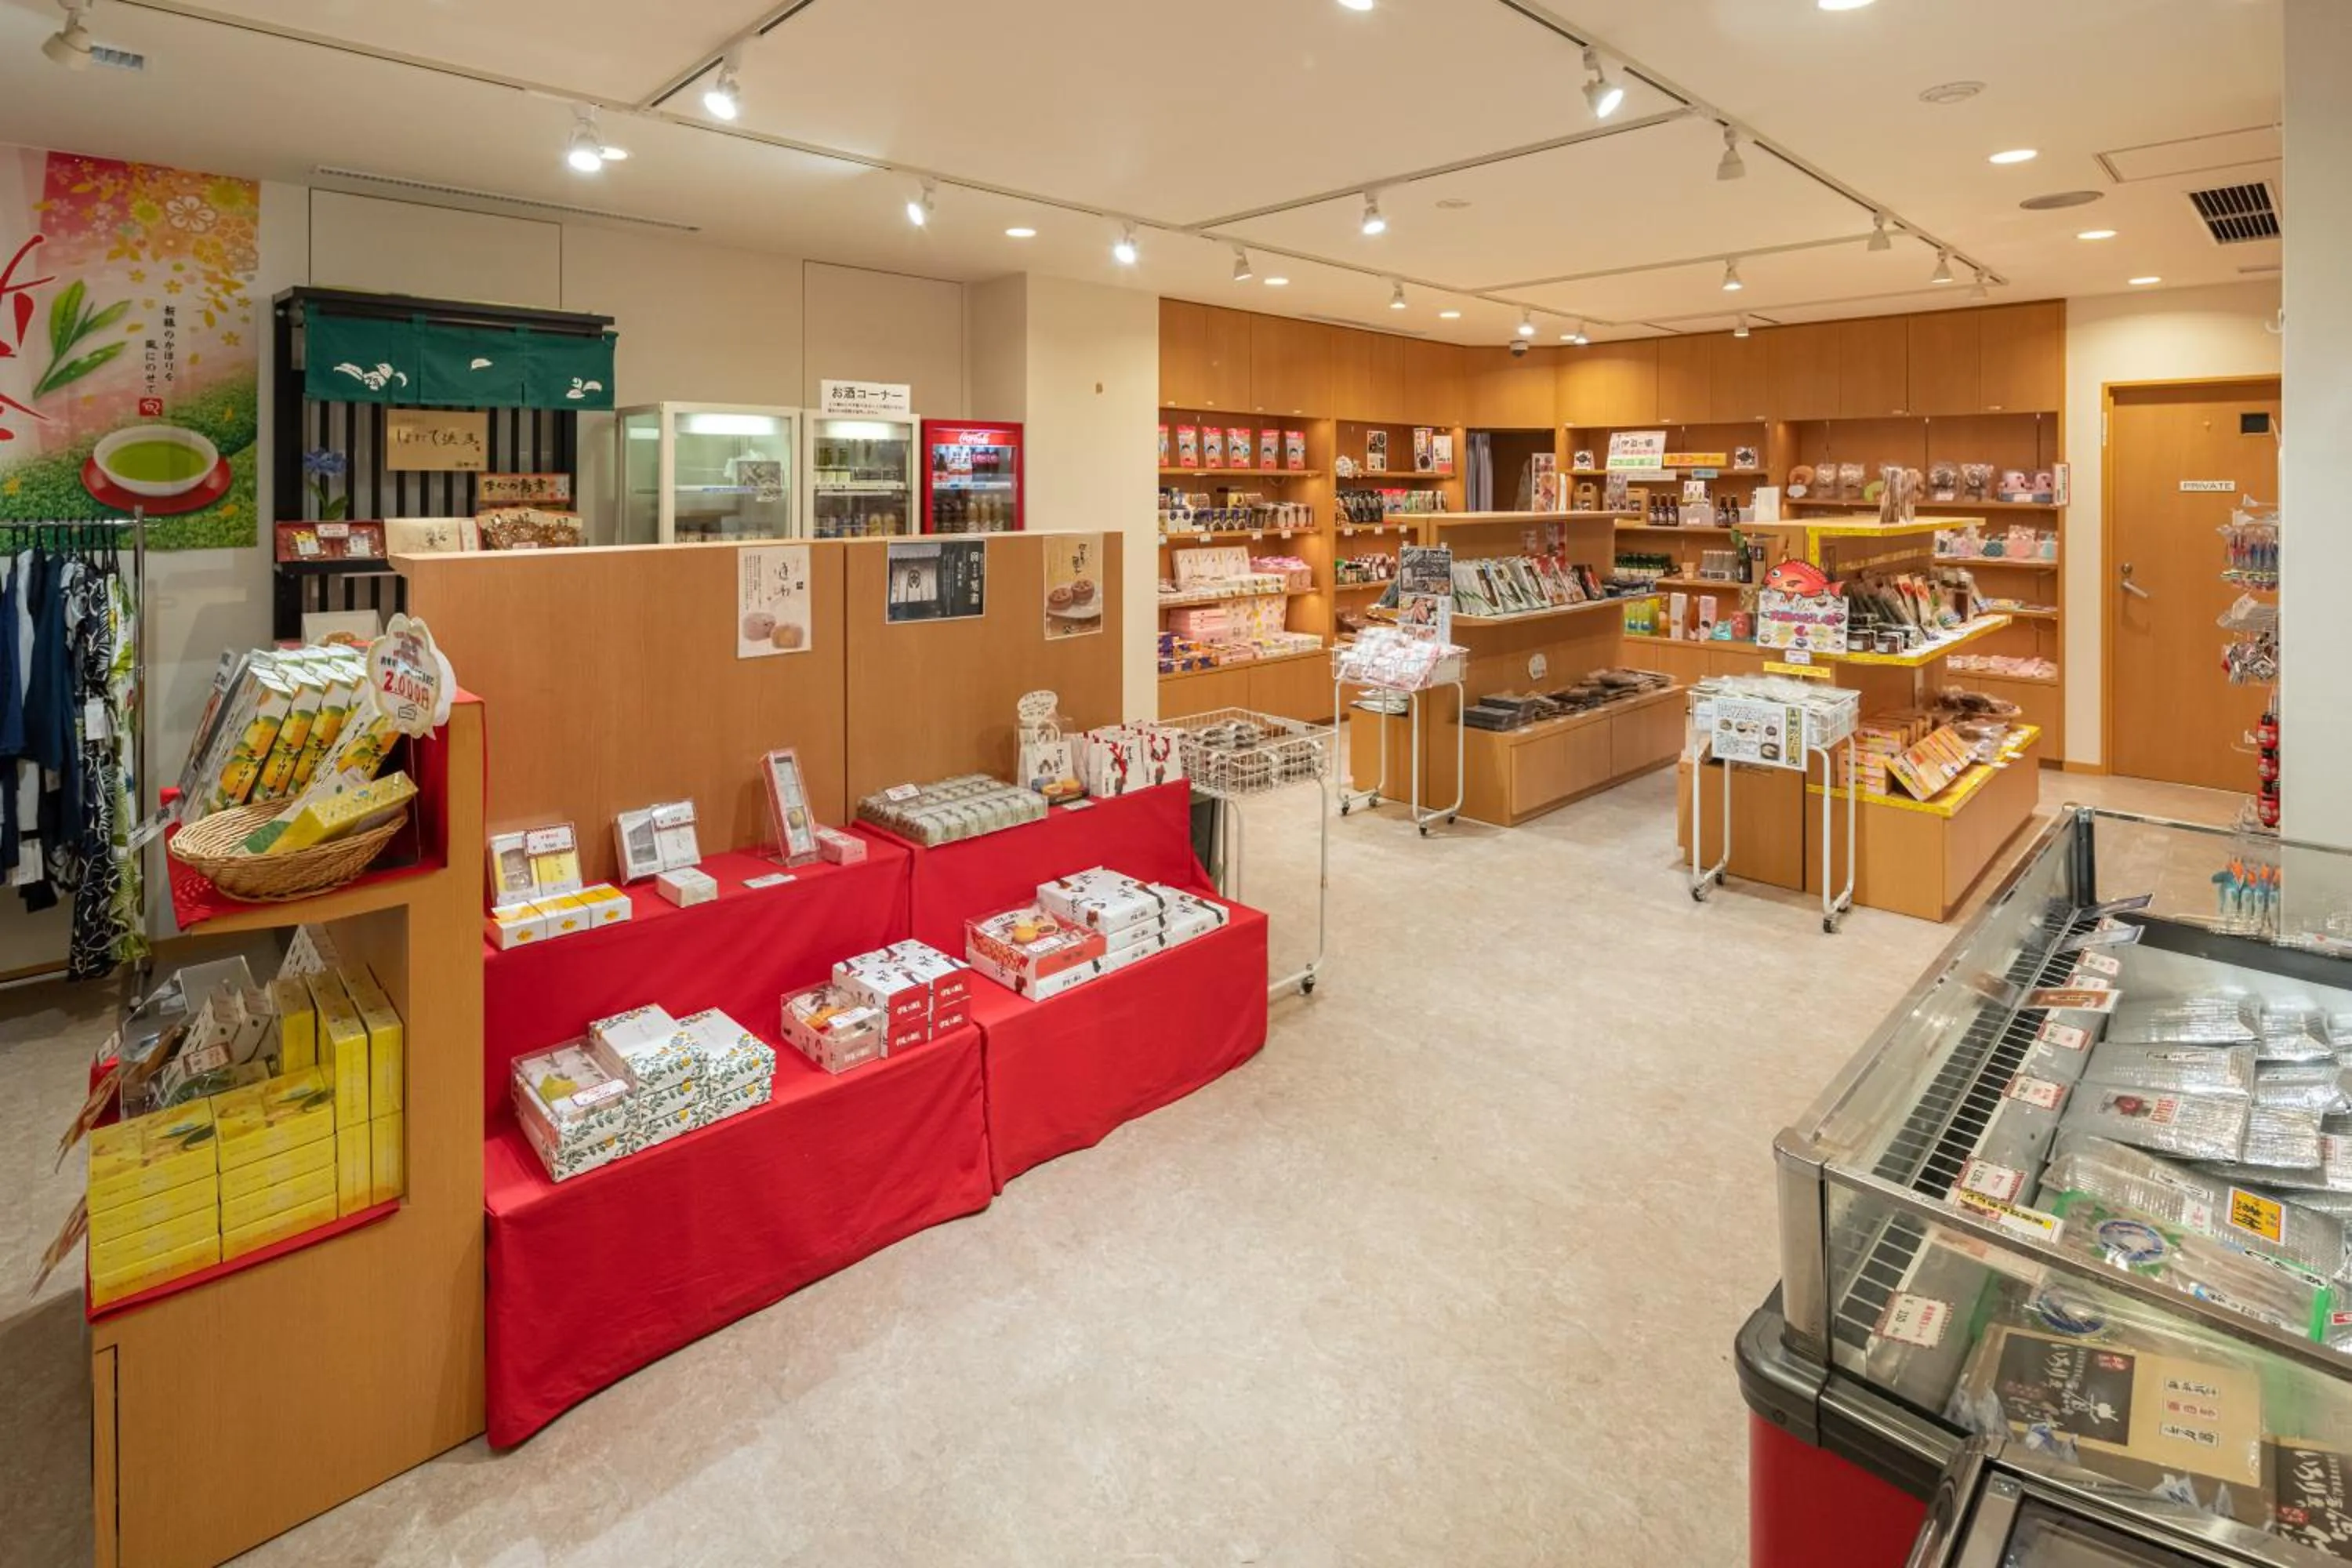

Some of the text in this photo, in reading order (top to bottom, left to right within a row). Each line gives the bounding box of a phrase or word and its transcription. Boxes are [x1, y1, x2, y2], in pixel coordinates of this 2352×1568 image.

[831, 386, 903, 401] お酒コーナー
[2183, 481, 2234, 491] PRIVATE
